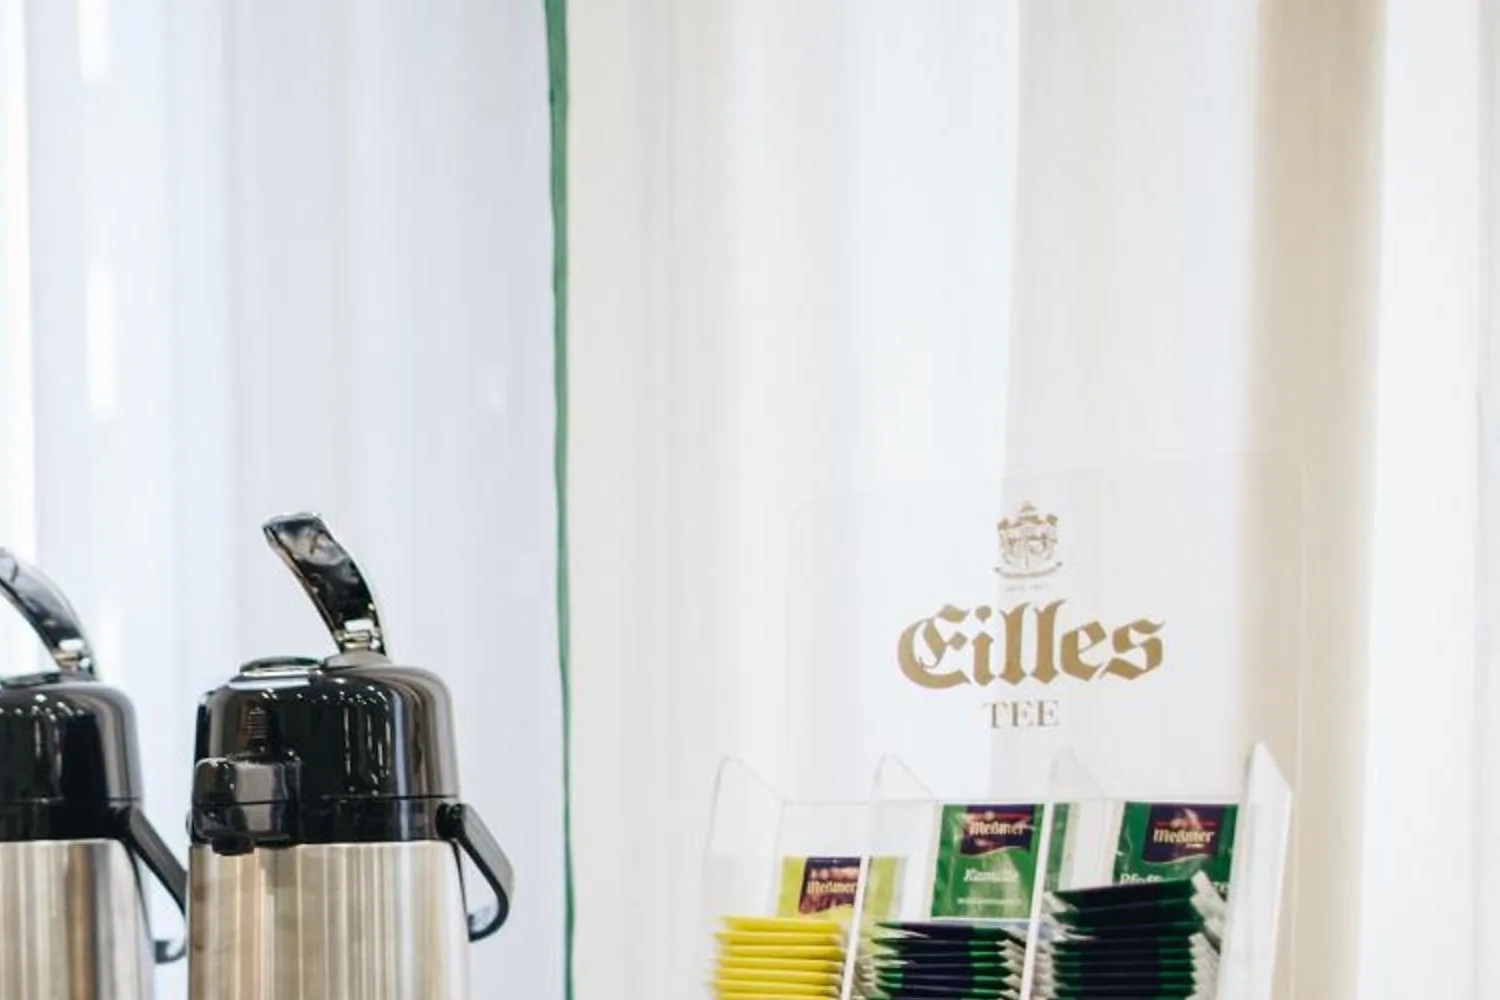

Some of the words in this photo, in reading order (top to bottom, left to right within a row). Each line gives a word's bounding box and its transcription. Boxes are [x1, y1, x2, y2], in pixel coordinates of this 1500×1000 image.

[897, 599, 1165, 689] Eilles
[983, 700, 1060, 728] TEE
[1153, 828, 1215, 843] Meßmer
